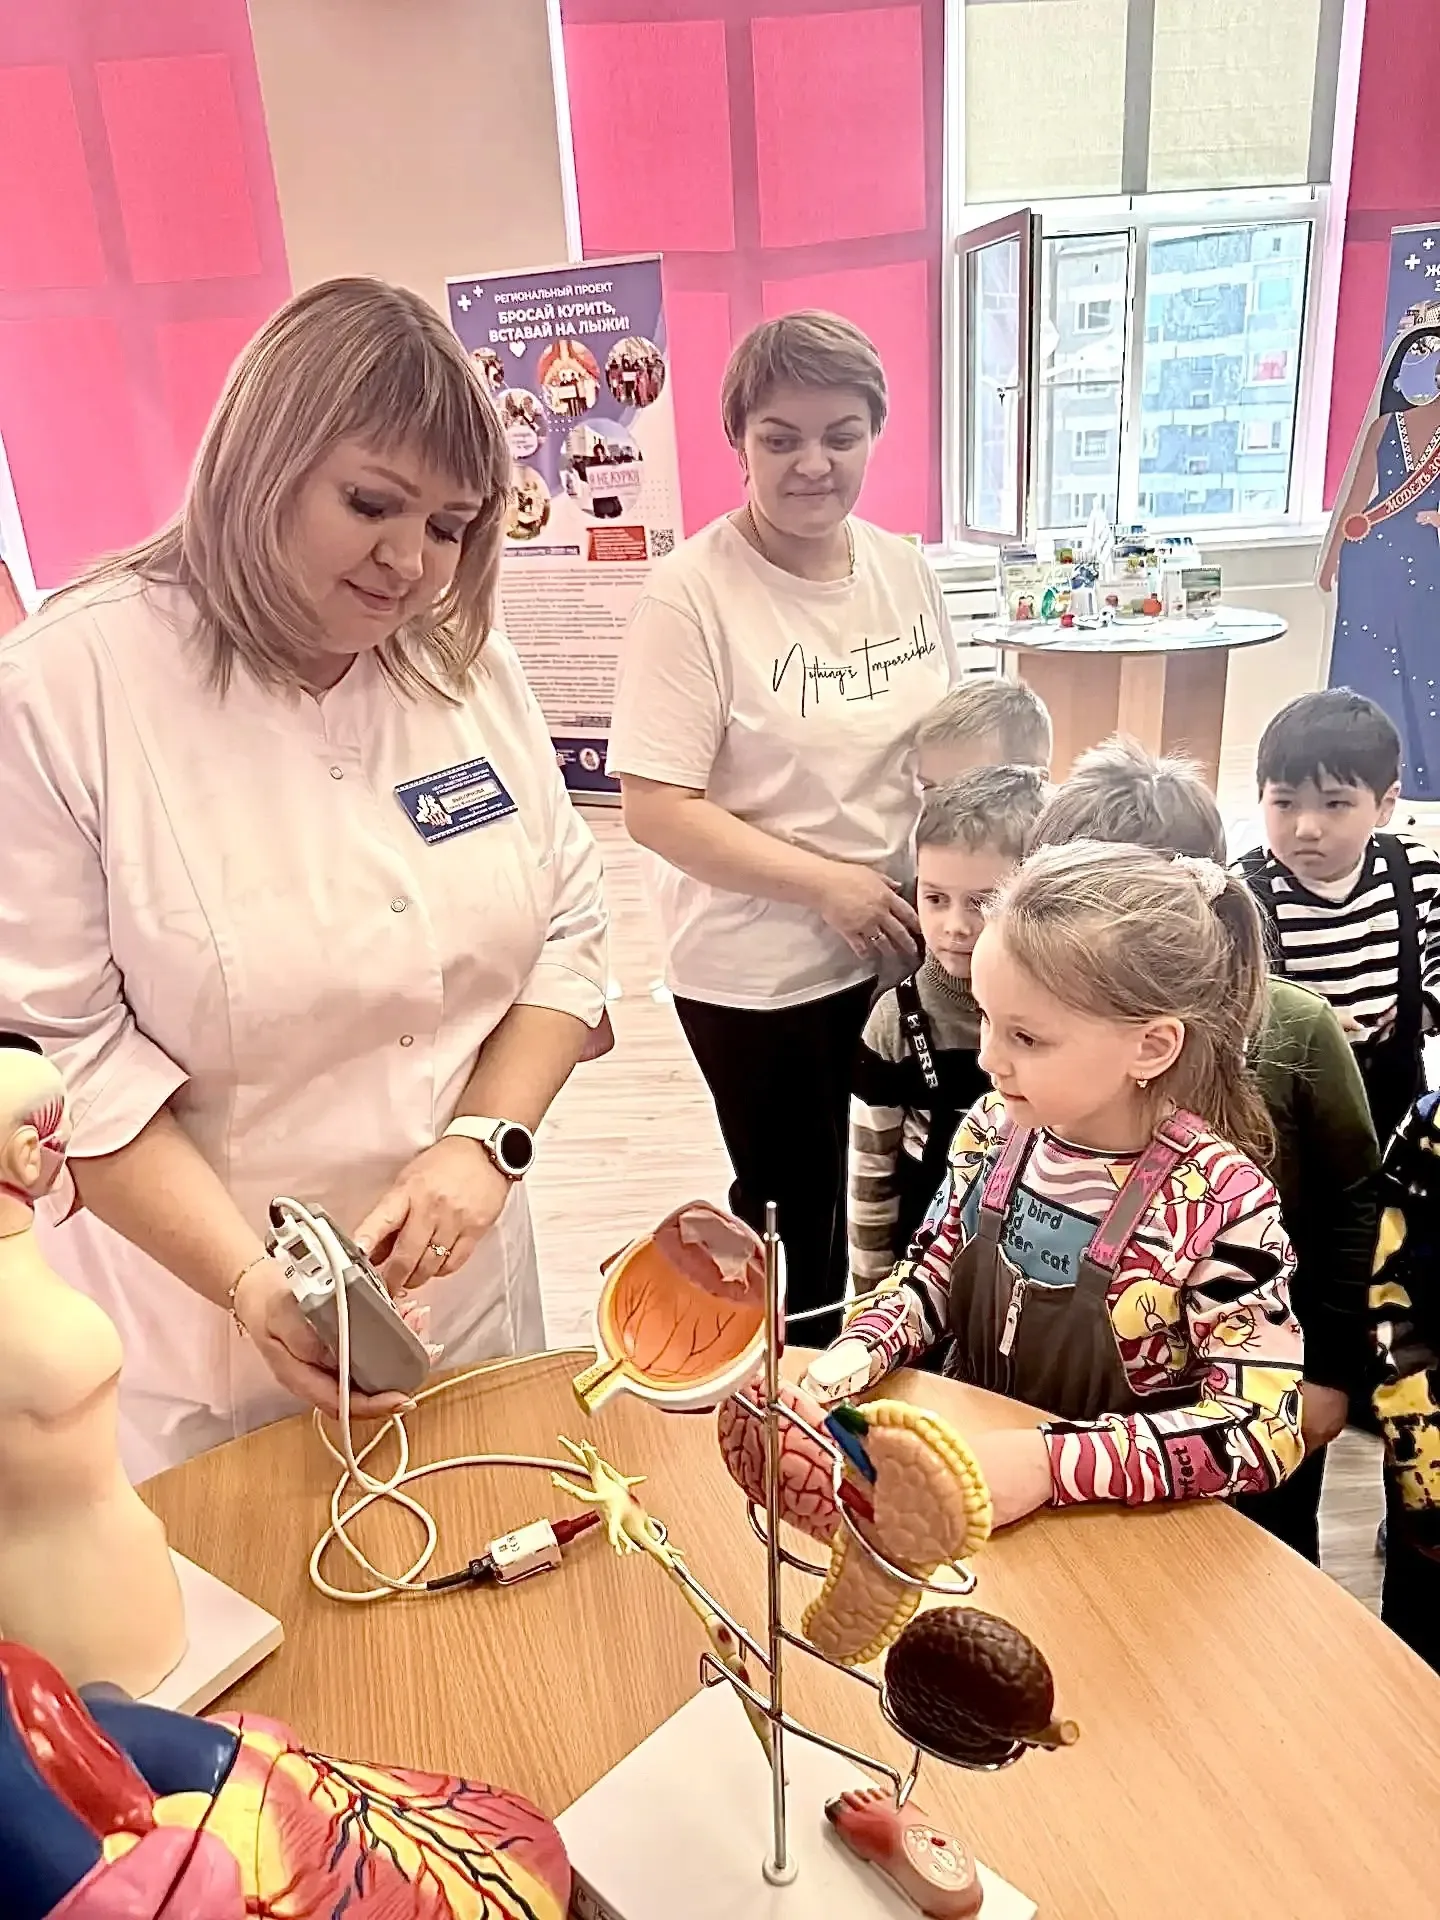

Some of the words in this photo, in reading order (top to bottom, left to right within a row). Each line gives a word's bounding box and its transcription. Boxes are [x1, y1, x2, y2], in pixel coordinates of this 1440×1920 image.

[494, 285, 573, 303] РЕГИОНАЛЬНЫЙ
[574, 282, 613, 296] ПРОЕКТ
[498, 303, 555, 324] БРОСАЙ
[557, 300, 616, 318] КУРИТЬ,
[488, 322, 553, 343] ВСТАВАЙ
[555, 321, 577, 337] НА
[579, 316, 630, 334] ЛЫЖИ!
[1028, 1199, 1064, 1230] bird
[1041, 1249, 1071, 1275] cat
